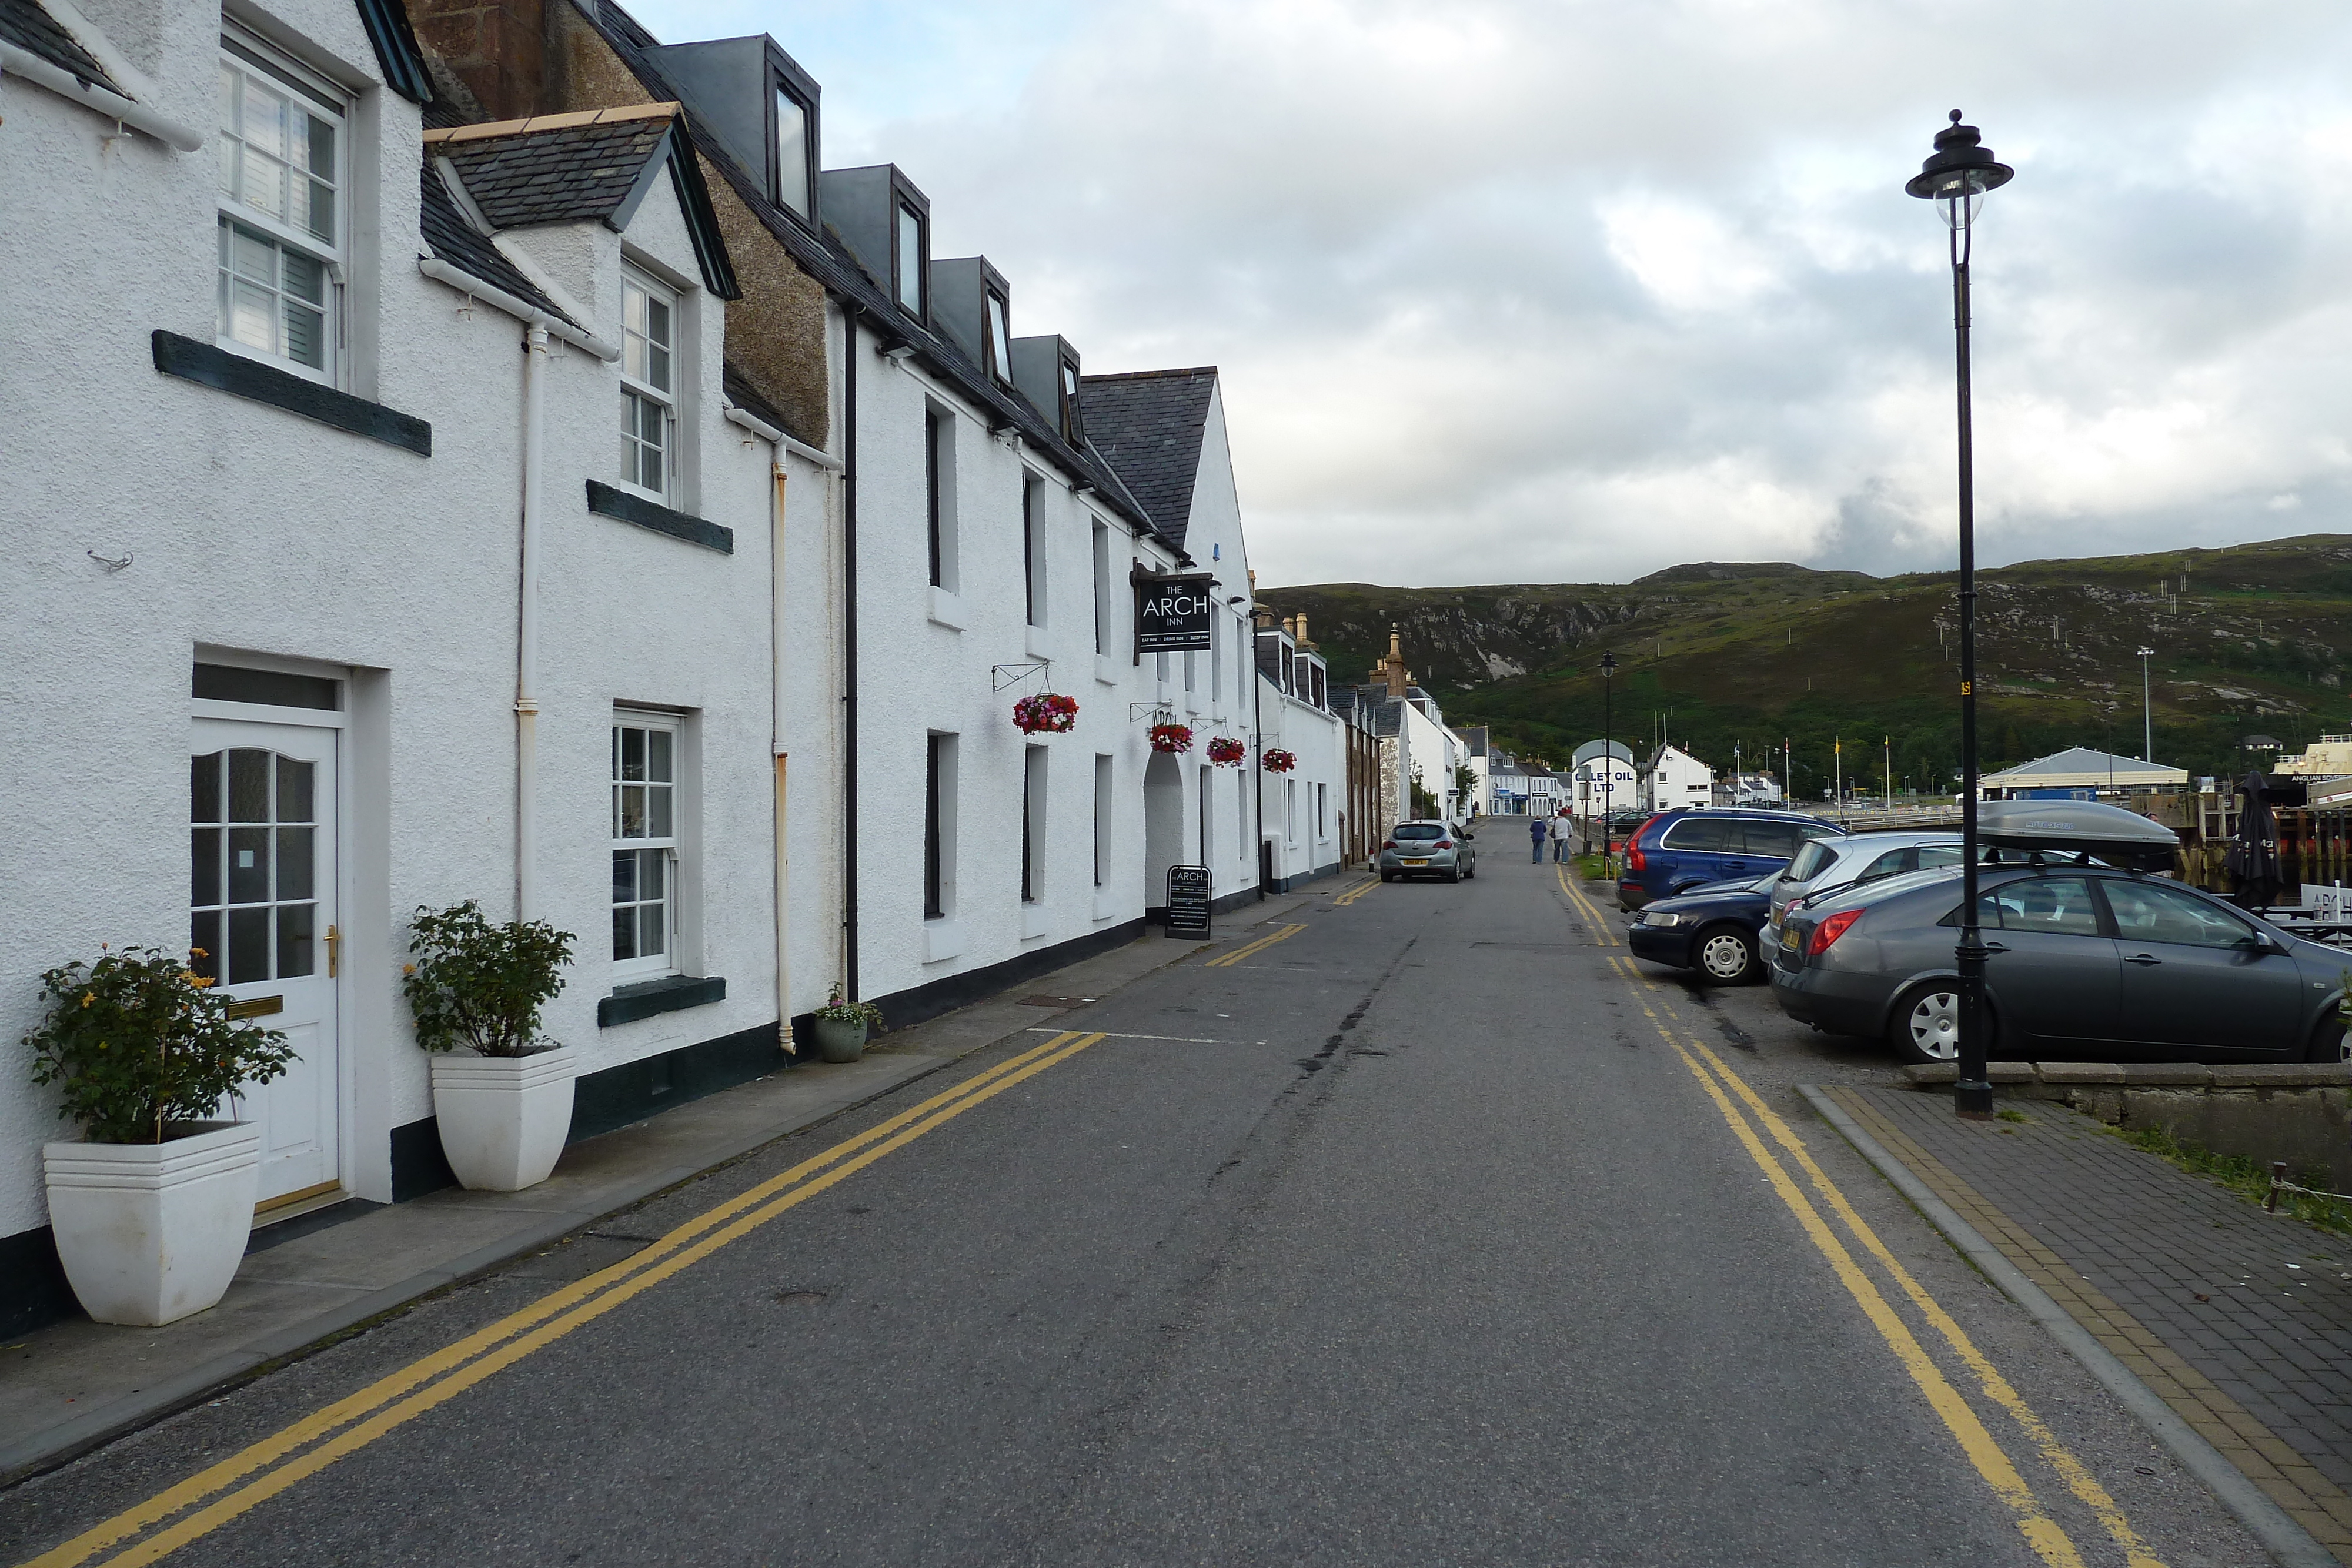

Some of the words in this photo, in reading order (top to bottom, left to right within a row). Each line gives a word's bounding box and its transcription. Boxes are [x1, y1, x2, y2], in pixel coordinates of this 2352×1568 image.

[1167, 586, 1182, 594] THE
[1143, 596, 1207, 617] ARCH
[1167, 617, 1183, 626] INN
[1575, 773, 1611, 781] LEY
[1615, 772, 1633, 780] OIL
[1594, 784, 1614, 792] LTD
[1177, 872, 1203, 881] ARCH
